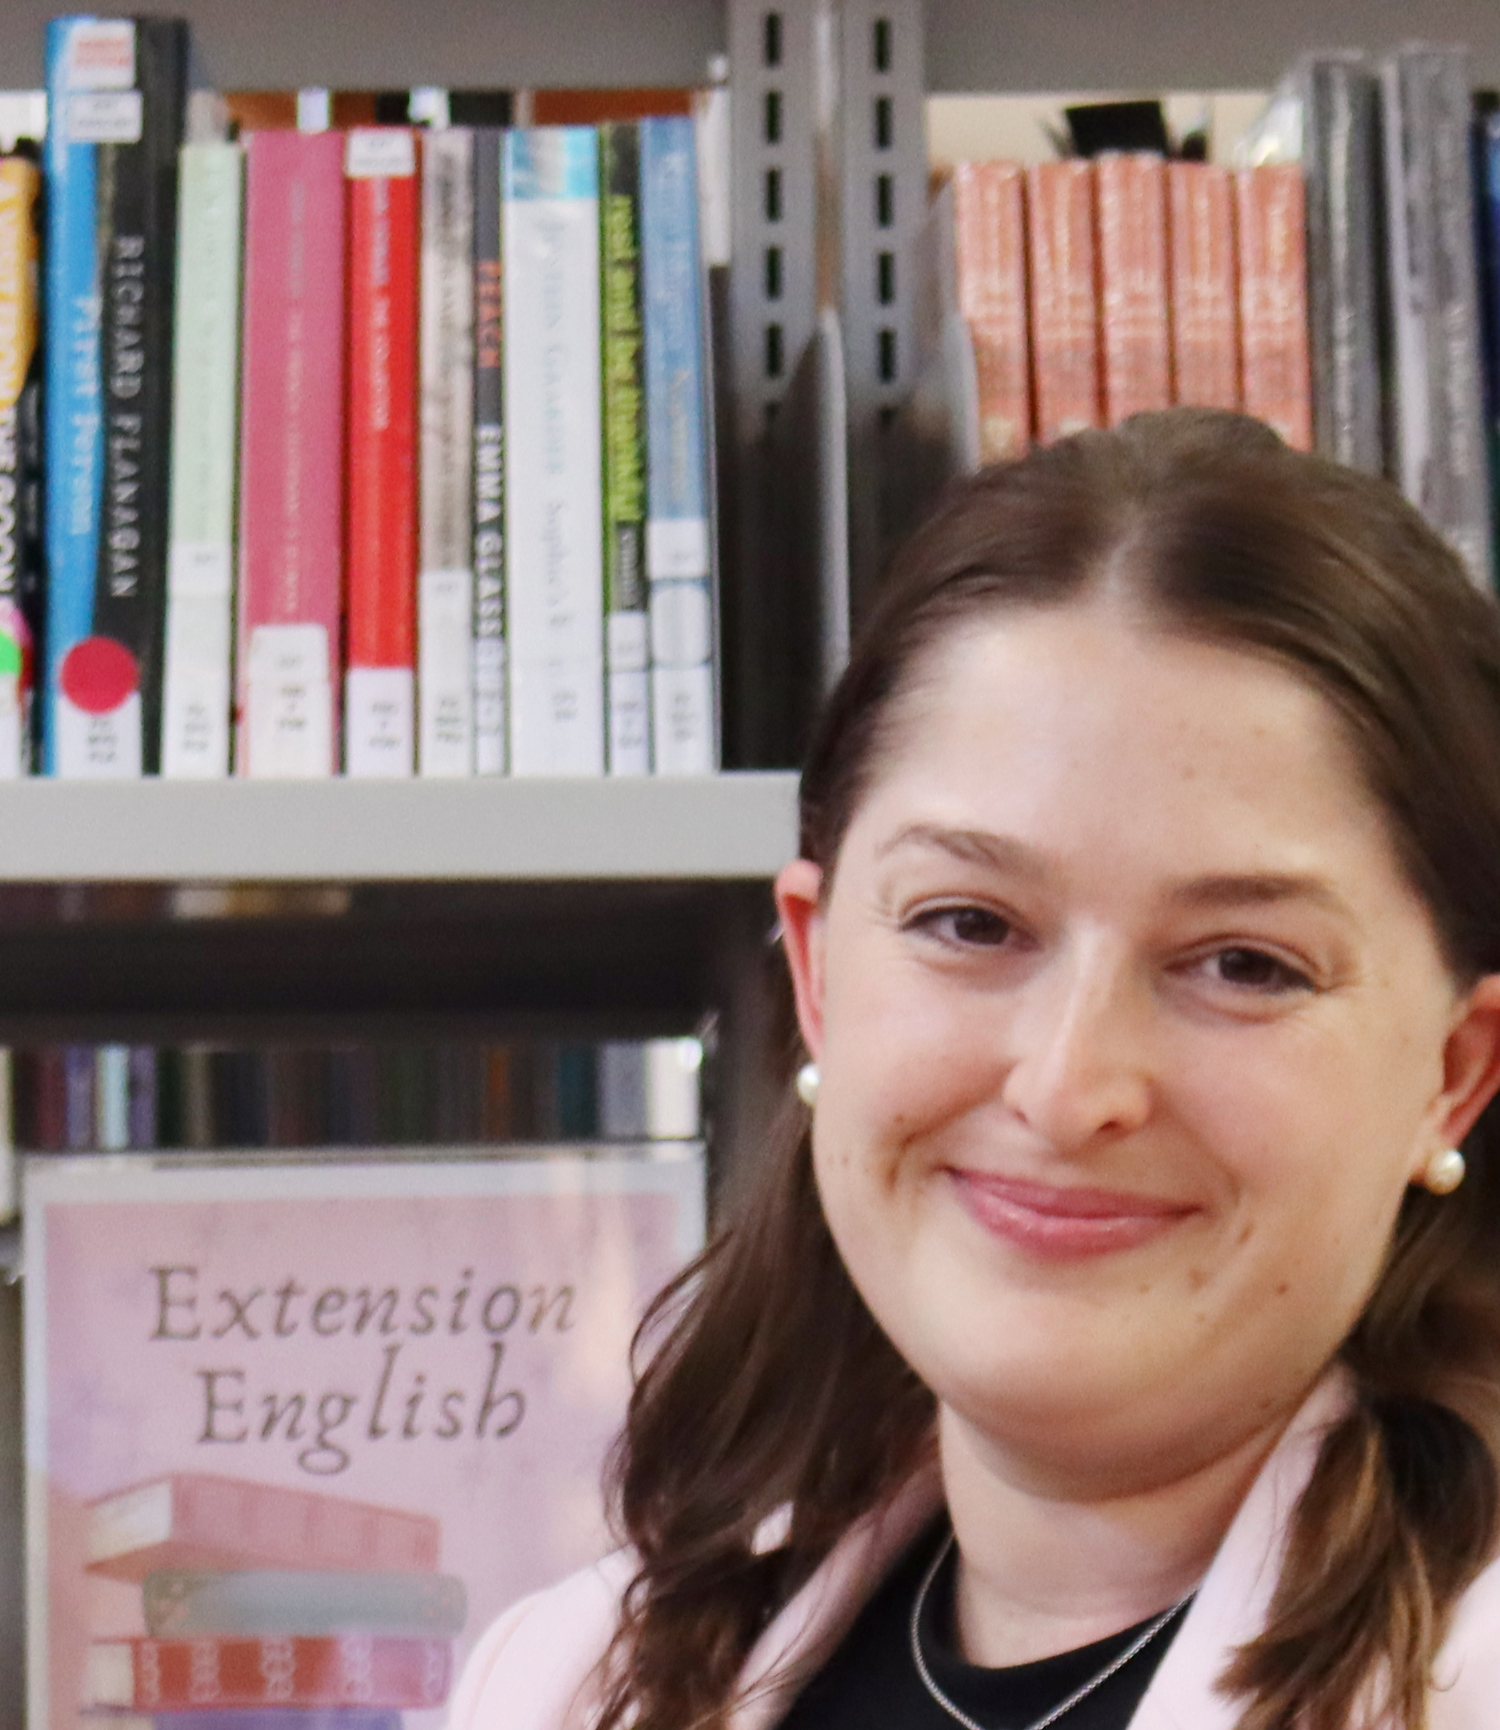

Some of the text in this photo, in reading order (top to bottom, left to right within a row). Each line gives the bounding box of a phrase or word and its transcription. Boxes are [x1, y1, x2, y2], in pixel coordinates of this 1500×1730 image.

[110, 235, 146, 597] RICHARD FLANAGAN
[478, 261, 505, 640] PEACH EMMA GLASS
[148, 1263, 578, 1345] Extension
[194, 1342, 530, 1478] English
